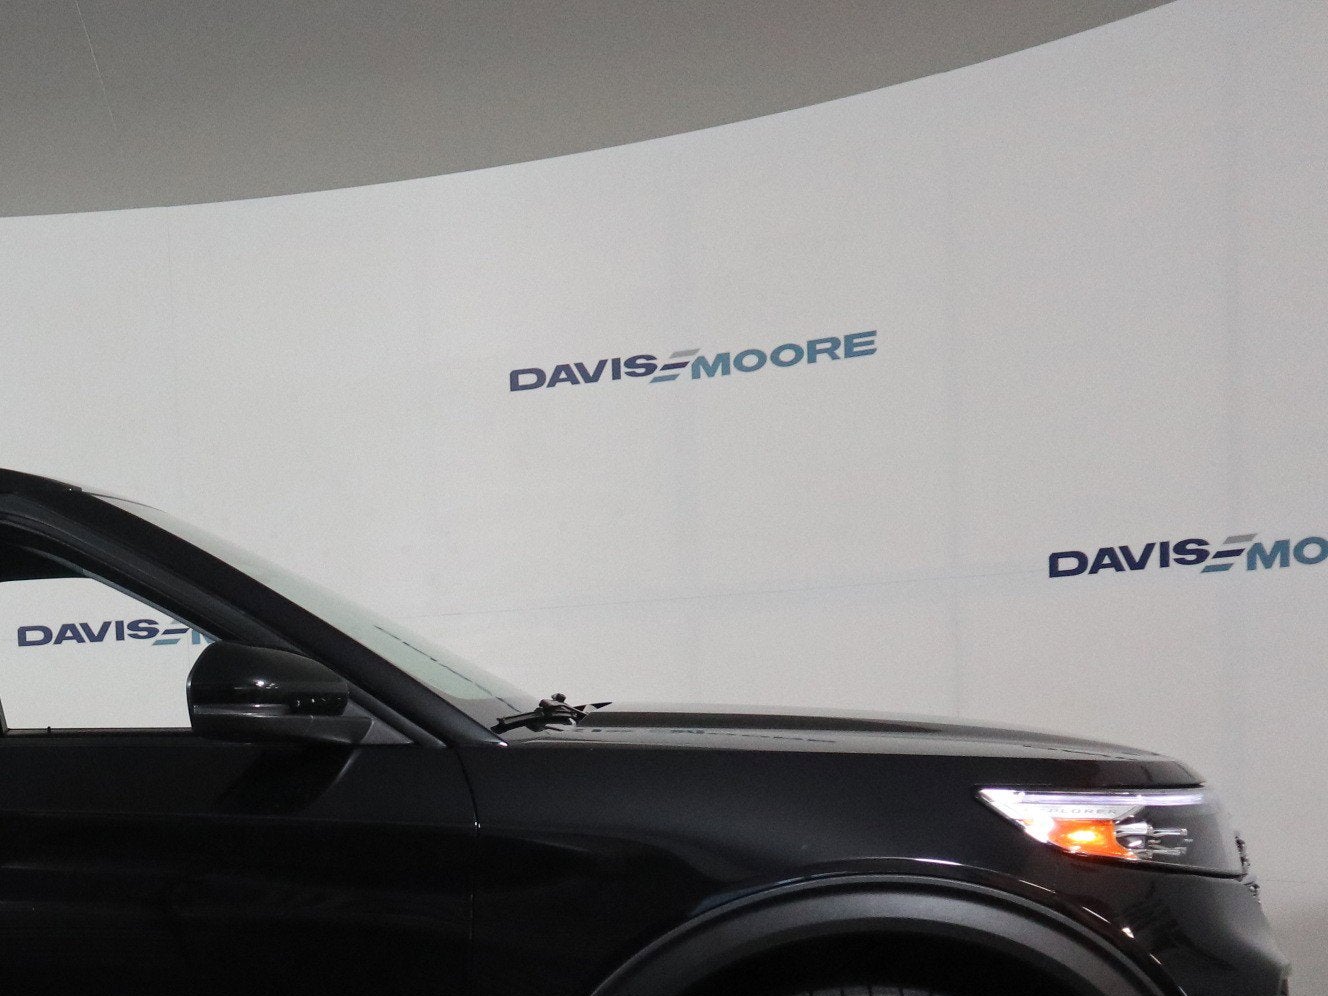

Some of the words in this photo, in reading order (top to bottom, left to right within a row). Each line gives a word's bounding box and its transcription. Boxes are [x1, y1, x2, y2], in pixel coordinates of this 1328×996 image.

[509, 354, 658, 392] DAVIS
[690, 330, 878, 380] MOORE
[1048, 538, 1211, 578] DAVIS
[17, 618, 160, 647] DAVIS
